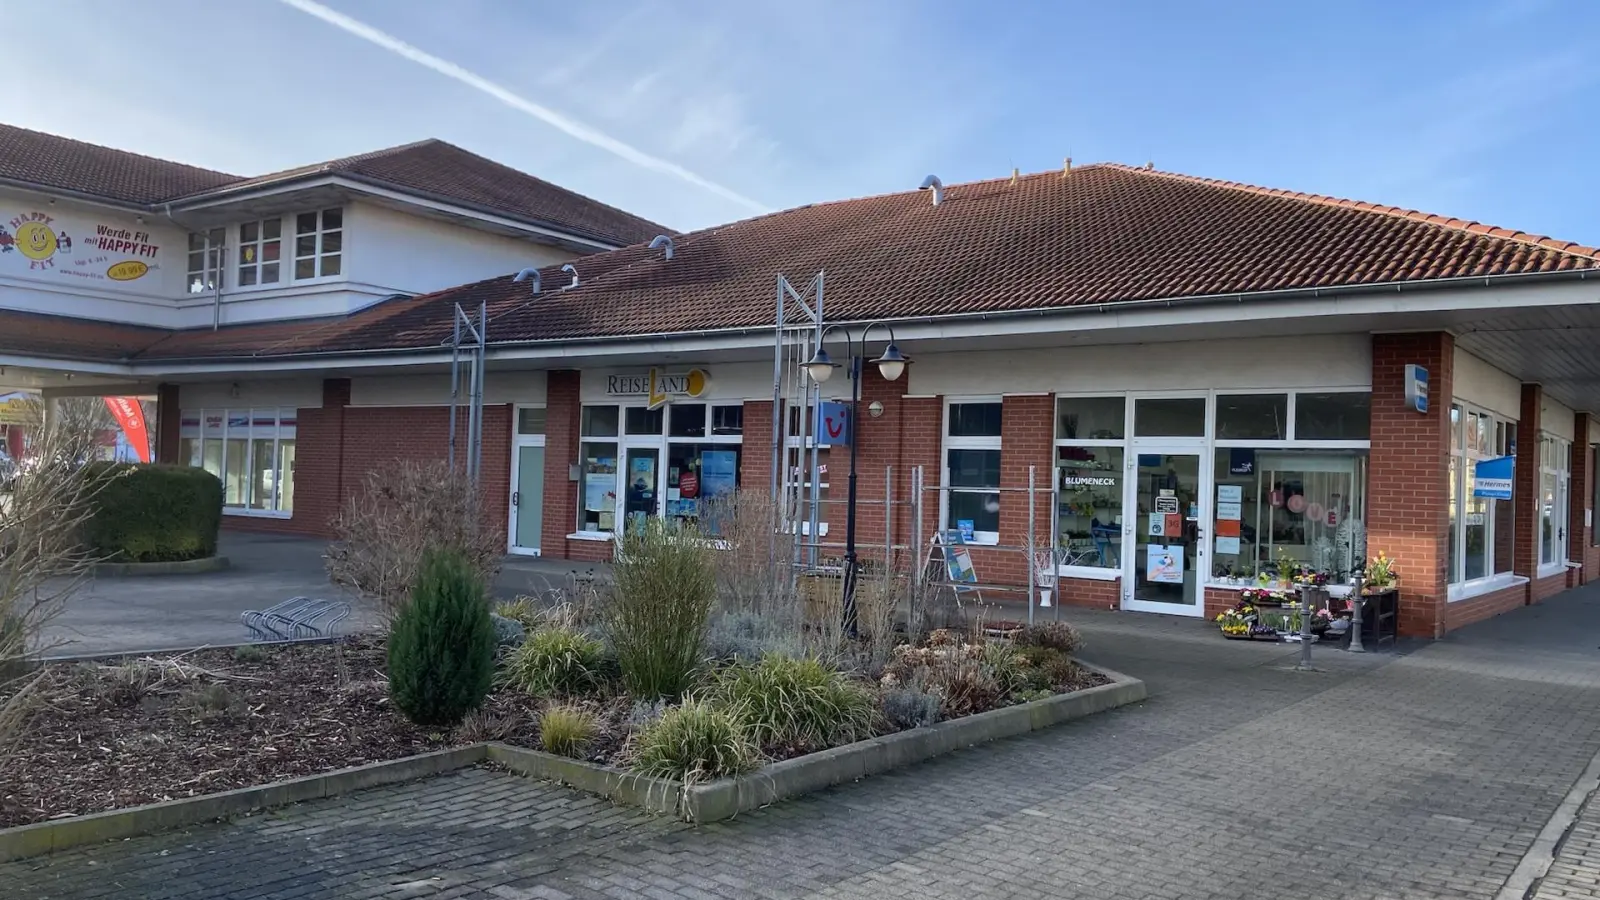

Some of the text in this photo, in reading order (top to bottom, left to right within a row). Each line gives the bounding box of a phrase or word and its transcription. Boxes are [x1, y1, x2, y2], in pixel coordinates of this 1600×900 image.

[9, 212, 54, 228] HAPPY
[97, 225, 149, 243] Werde Fit
[84, 237, 159, 258] mit HAPPY FIT
[30, 258, 54, 270] FIT
[1065, 477, 1115, 485] BLUMENECK
[1167, 520, 1180, 528] 3G
